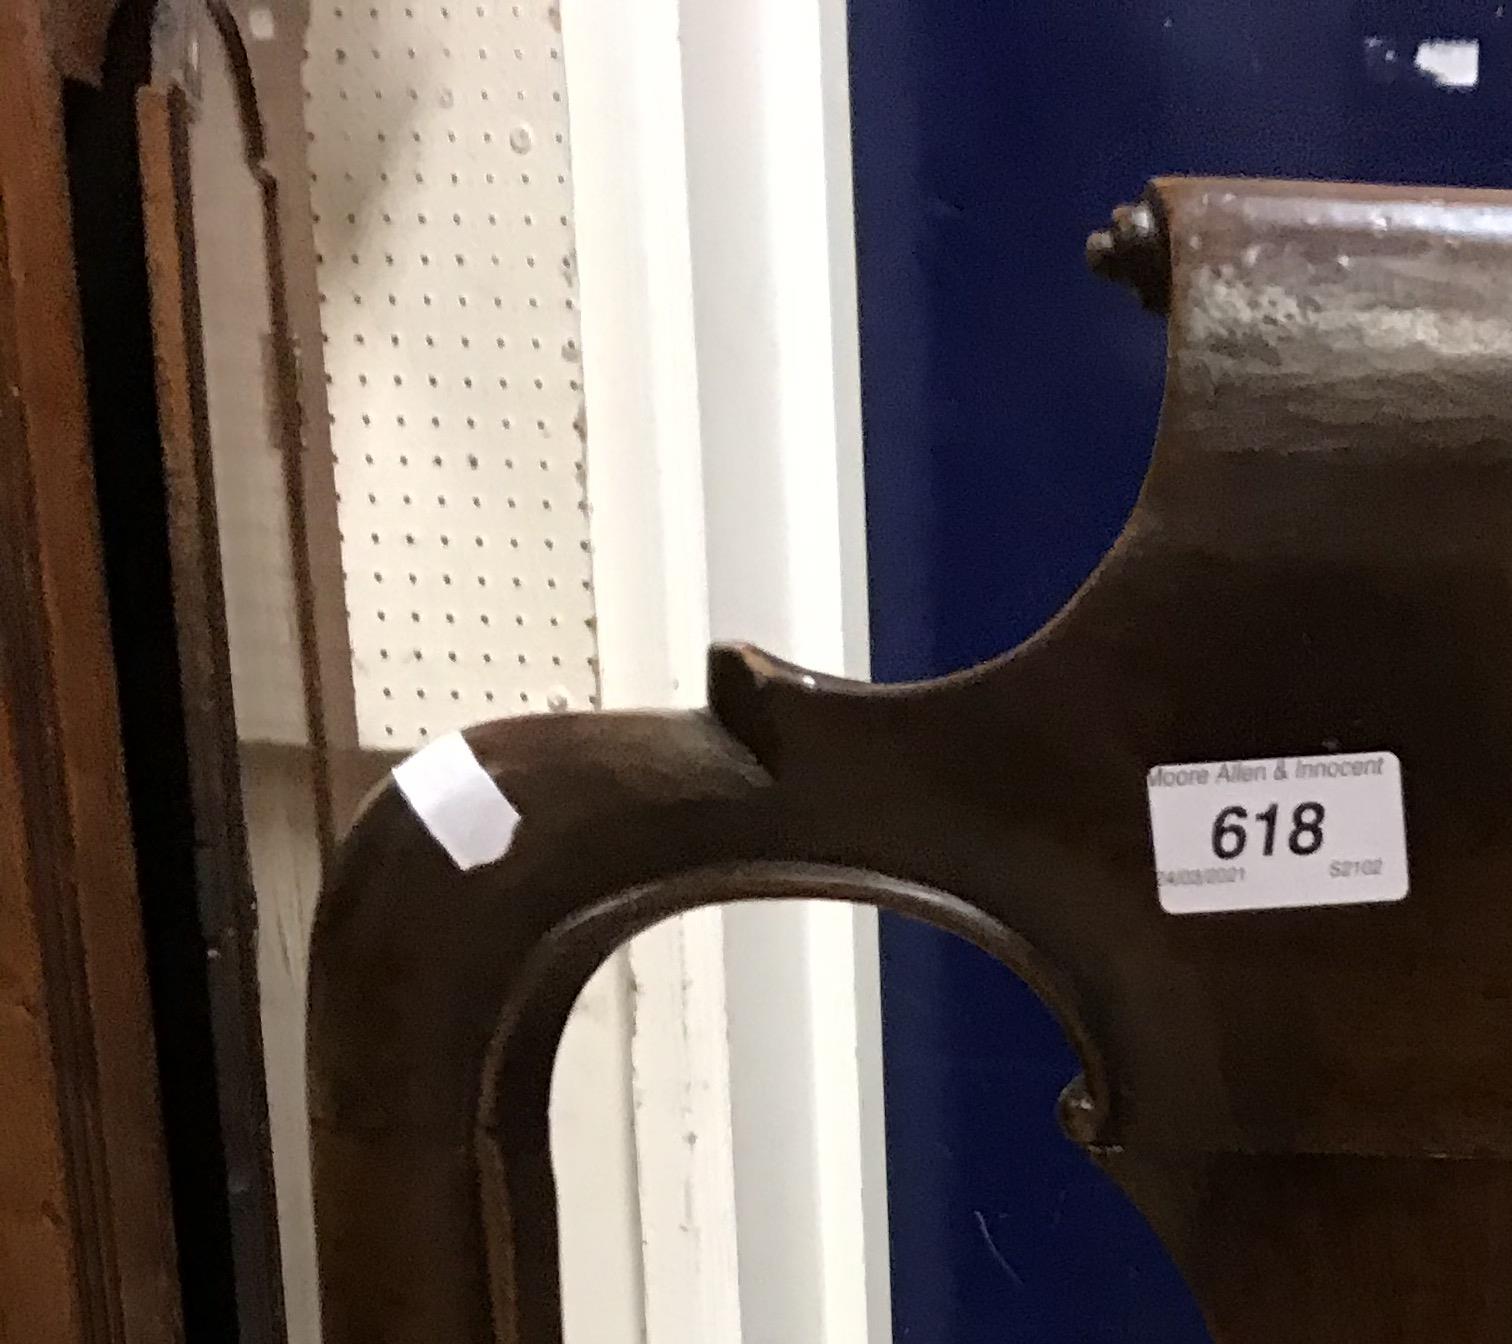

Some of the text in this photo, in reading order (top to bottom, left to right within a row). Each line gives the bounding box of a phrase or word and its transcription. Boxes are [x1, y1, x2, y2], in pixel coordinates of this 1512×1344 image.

[1216, 763, 1266, 783] Allen
[1273, 760, 1287, 781] &
[1295, 757, 1384, 779] Innocent
[1212, 801, 1326, 861] 618
